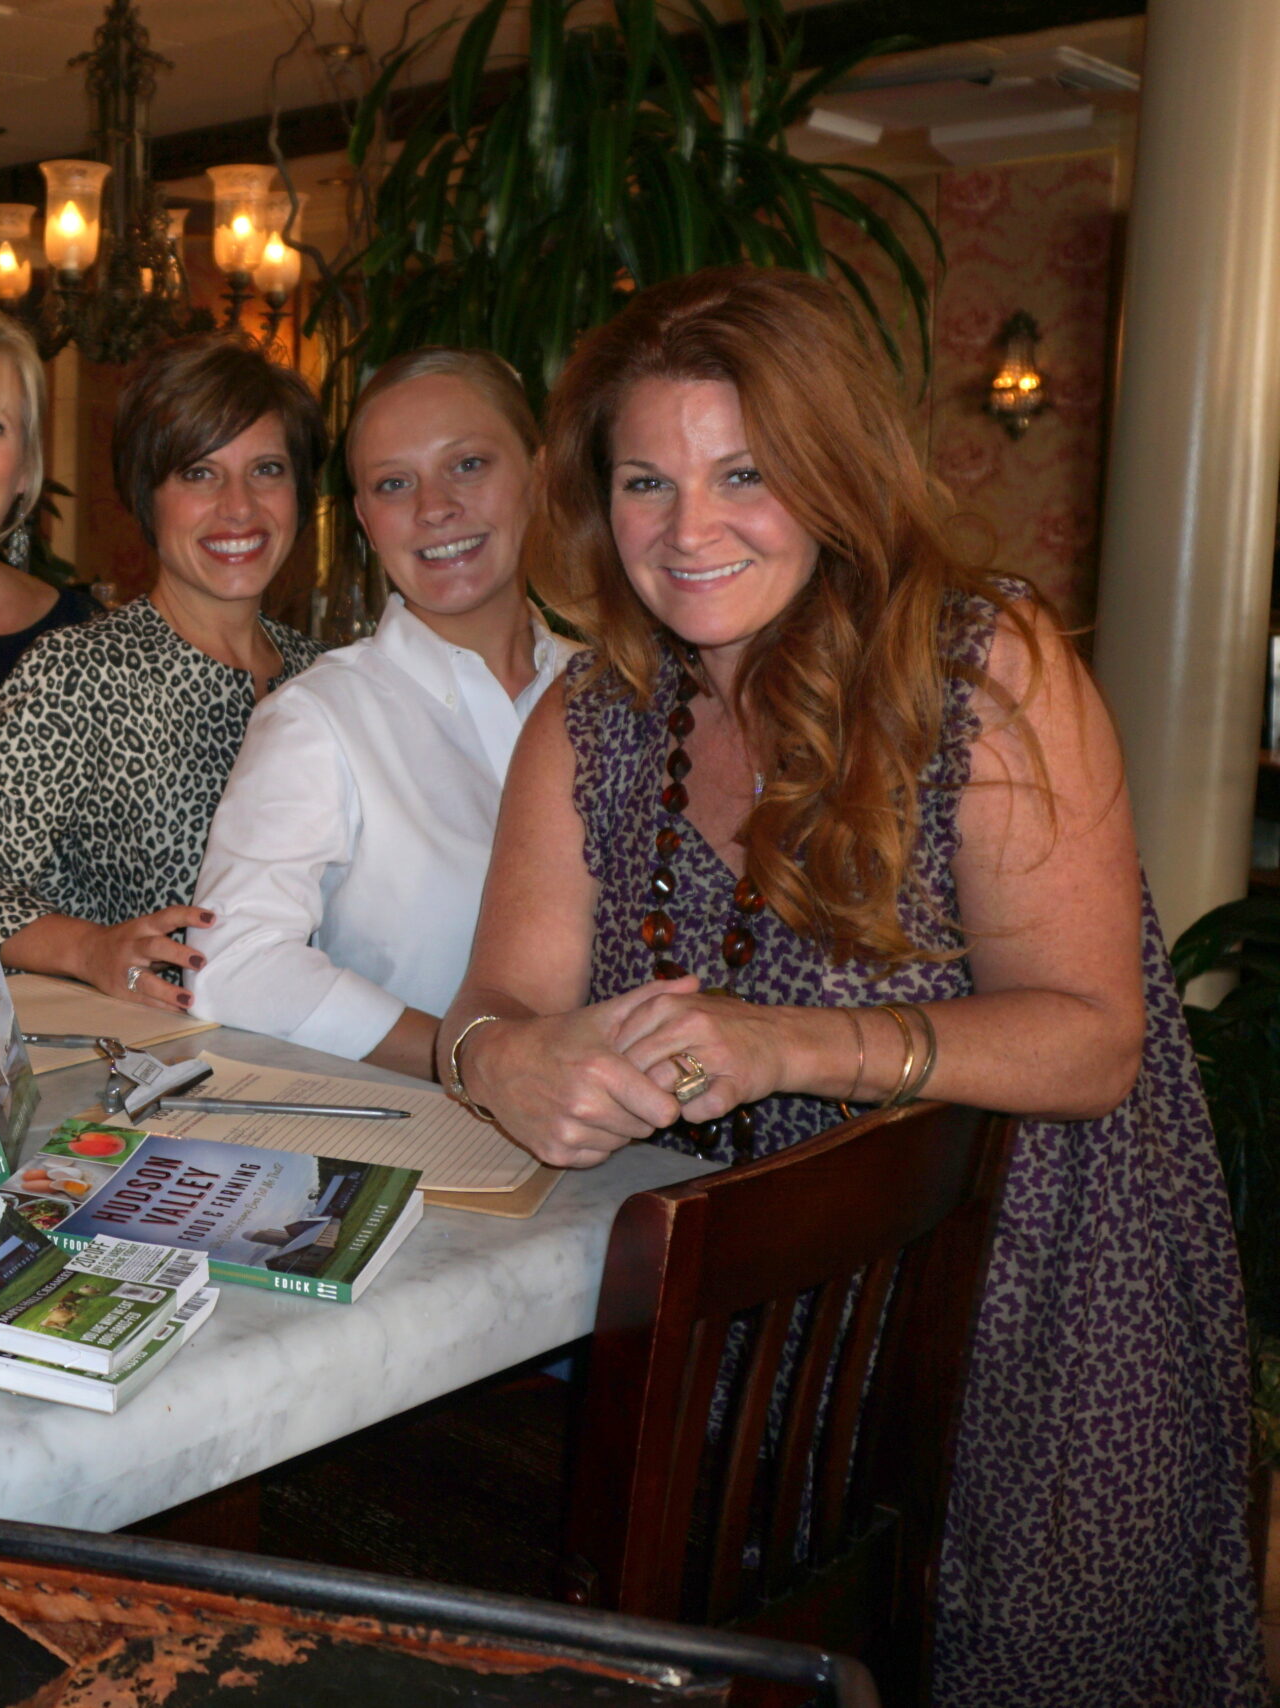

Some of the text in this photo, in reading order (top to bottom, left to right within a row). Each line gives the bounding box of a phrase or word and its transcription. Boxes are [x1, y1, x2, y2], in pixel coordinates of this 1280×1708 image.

[91, 1155, 183, 1224] HUDSON
[139, 1166, 221, 1226] VALLEY
[177, 1218, 217, 1242] FOOD
[210, 1163, 262, 1208] FARMING
[348, 1230, 372, 1251] TESSA
[366, 1204, 389, 1227] EDICK
[274, 1276, 311, 1294] EDICK
